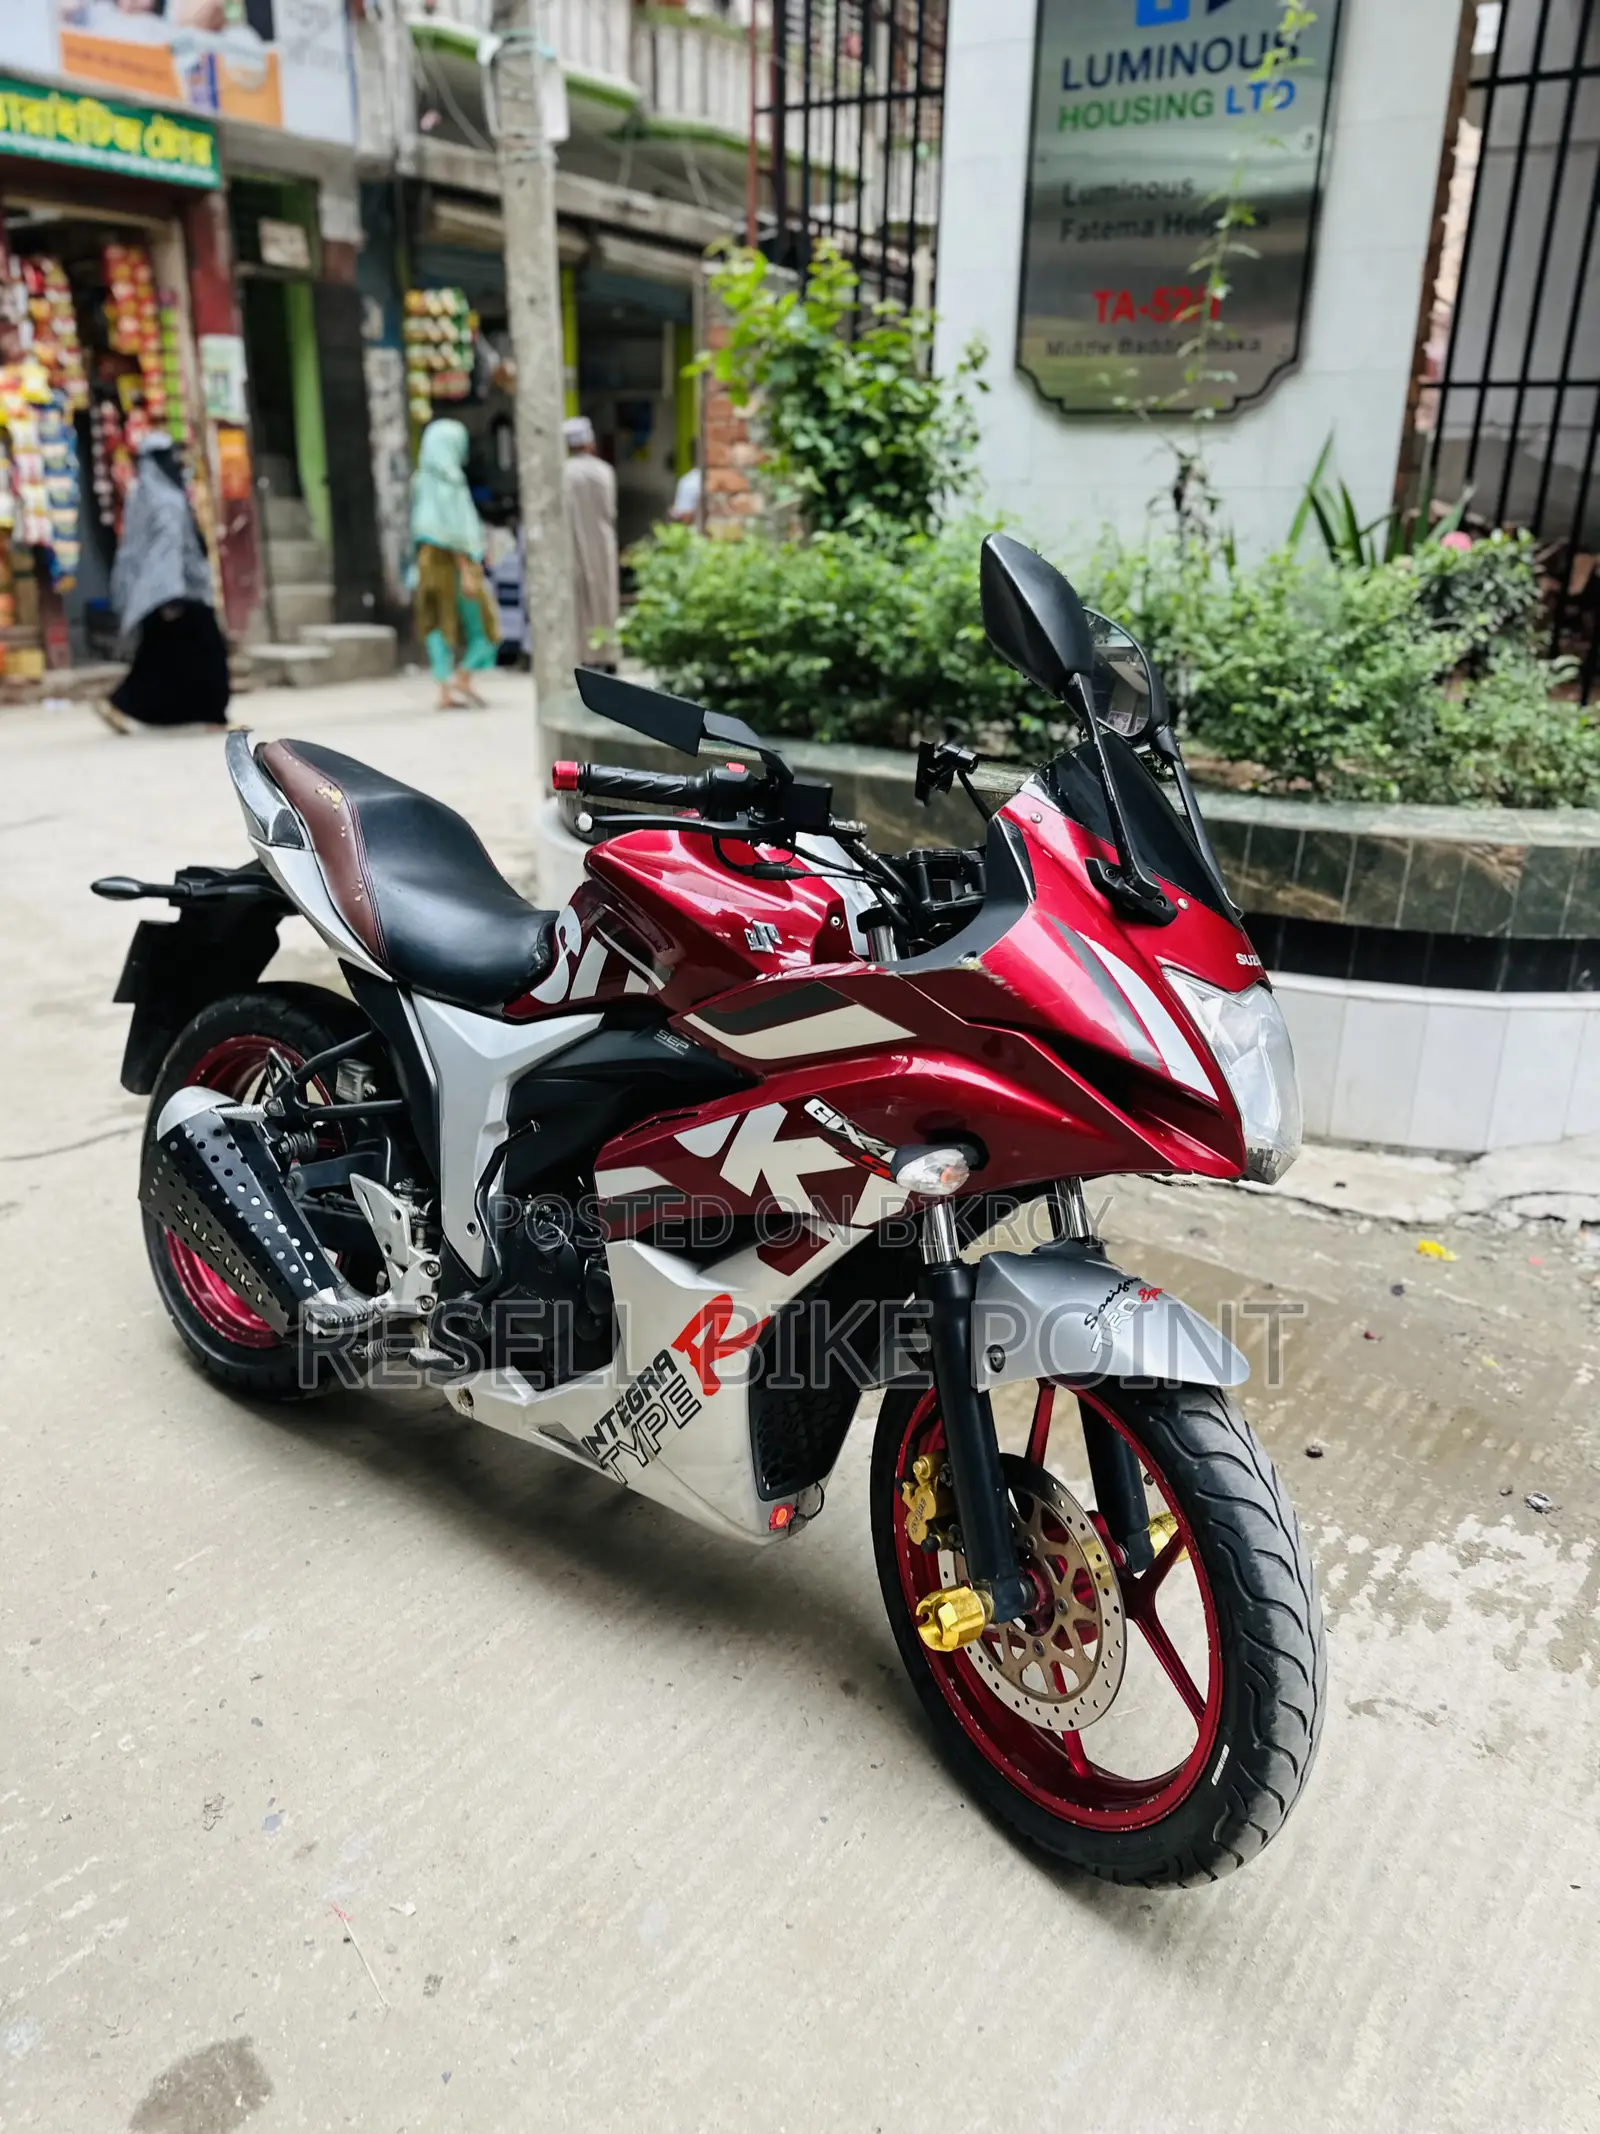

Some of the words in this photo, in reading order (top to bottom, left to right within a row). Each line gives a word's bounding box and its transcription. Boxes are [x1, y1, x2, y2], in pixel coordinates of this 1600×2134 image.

[1062, 30, 1300, 92] LUMINOUS
[1058, 88, 1215, 133] HOUSING
[1225, 79, 1296, 116] LTD
[657, 1029, 689, 1049] SEP
[174, 1204, 263, 1304] SUZUKI
[581, 1349, 678, 1457] INTEGRA
[599, 1373, 702, 1485] TYPE
[671, 1293, 772, 1396] R
